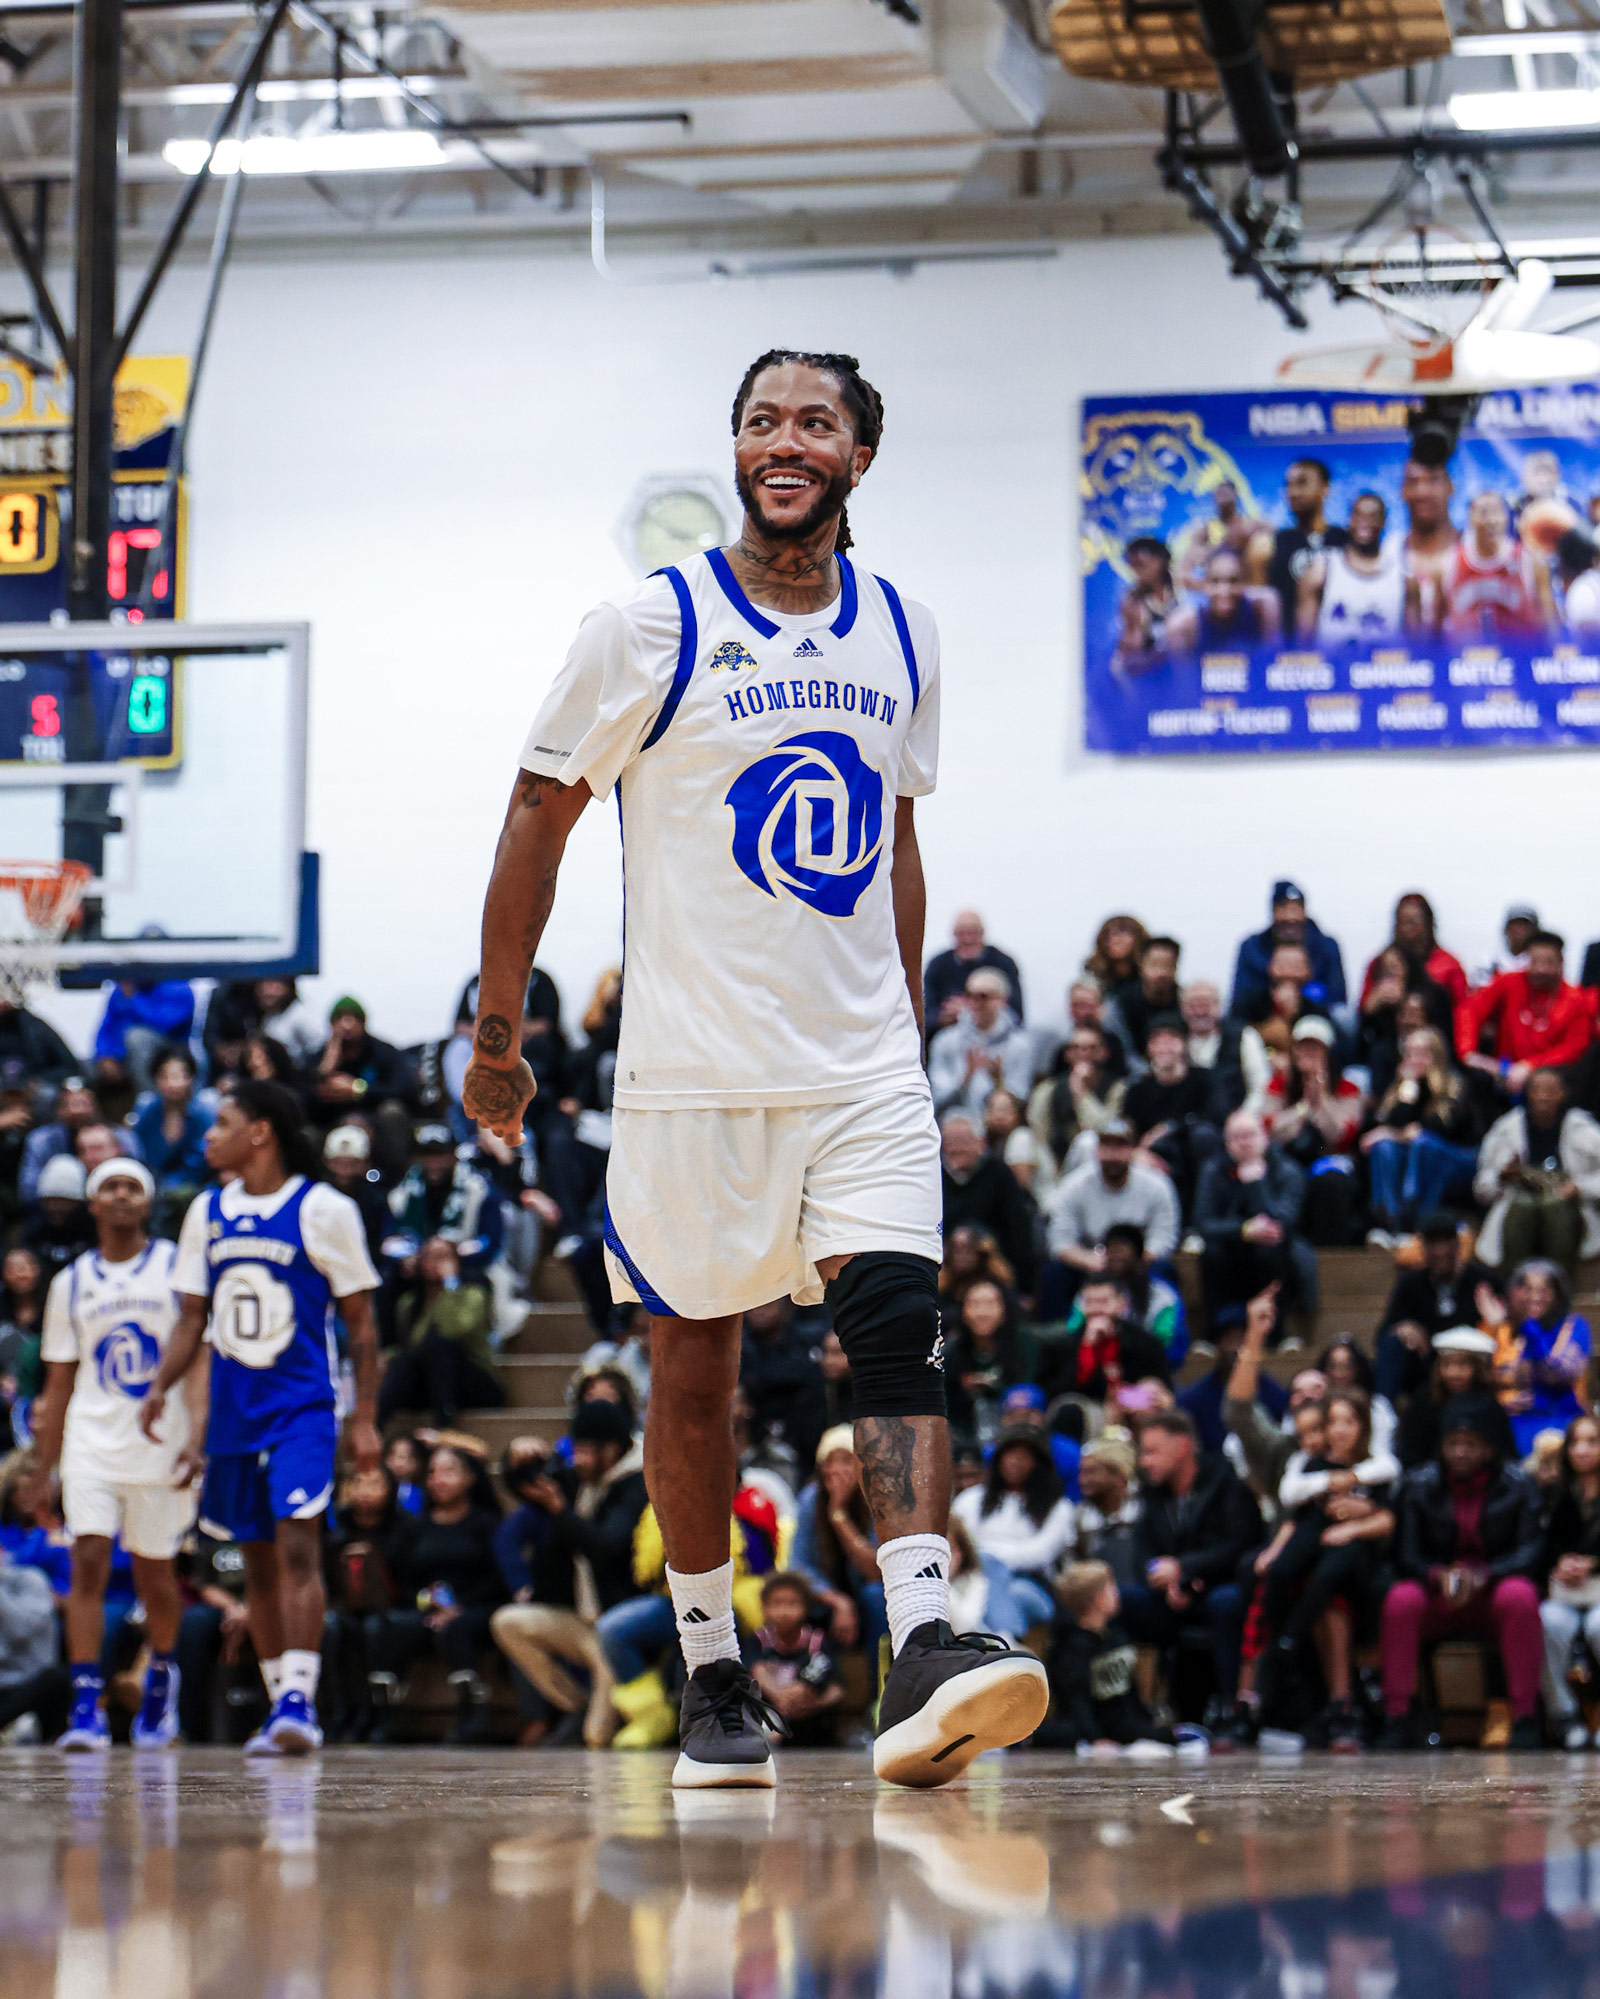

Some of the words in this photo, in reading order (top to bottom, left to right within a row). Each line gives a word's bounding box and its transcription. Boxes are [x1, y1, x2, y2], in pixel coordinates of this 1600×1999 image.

[1249, 402, 1326, 436] NBA
[793, 650, 824, 658] adidas
[128, 675, 166, 733] 0
[724, 680, 897, 726] HOMEGROWN
